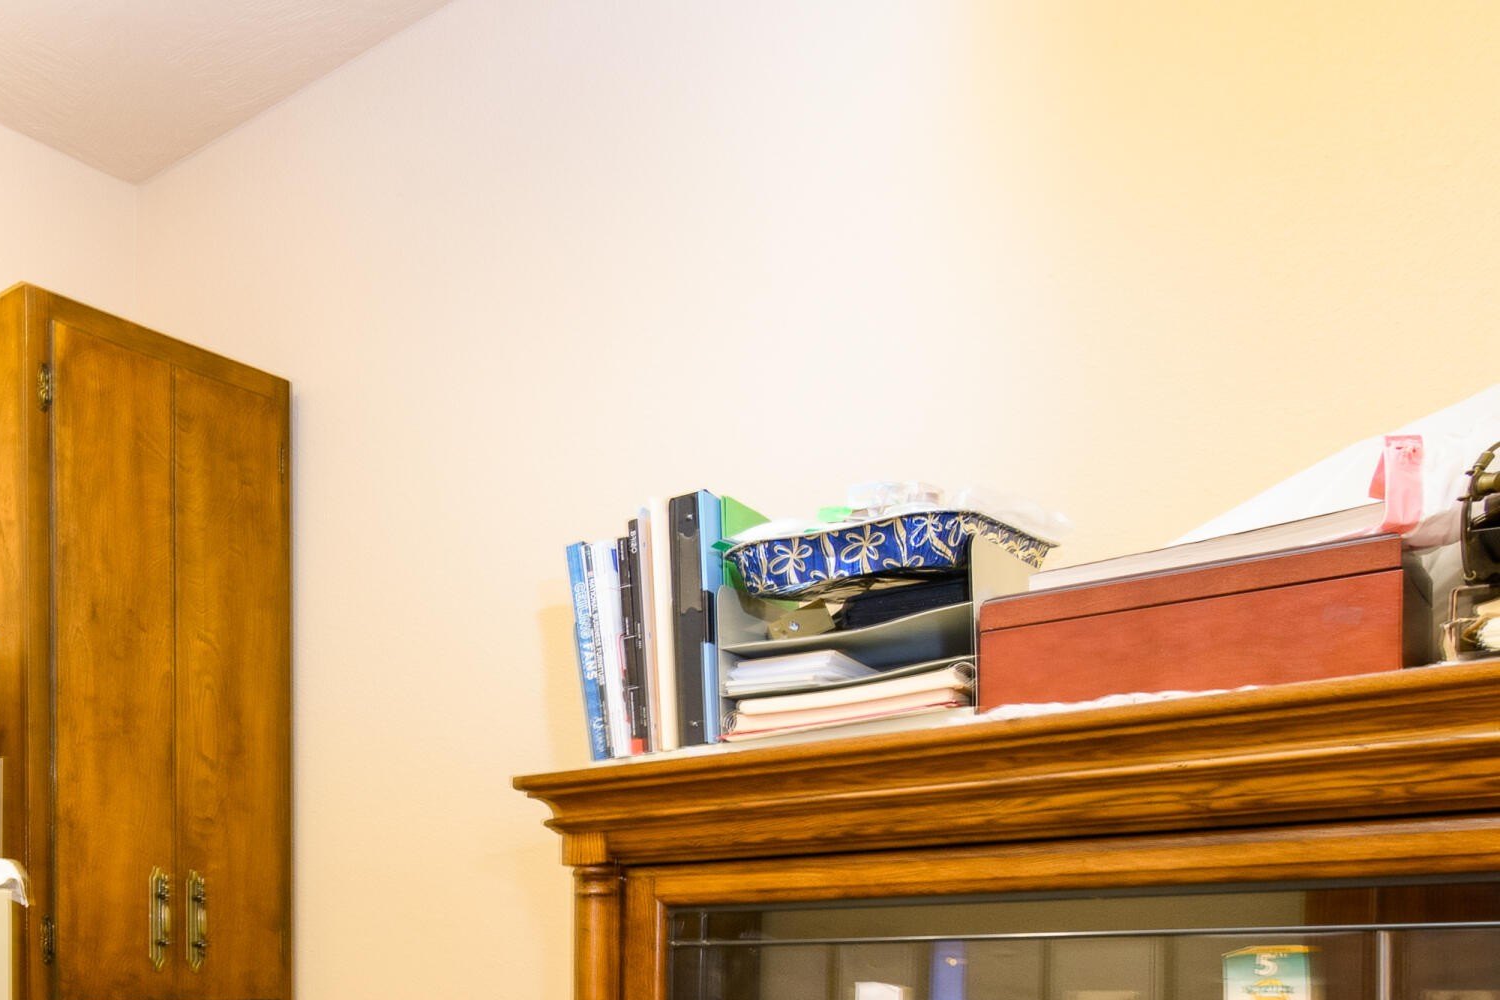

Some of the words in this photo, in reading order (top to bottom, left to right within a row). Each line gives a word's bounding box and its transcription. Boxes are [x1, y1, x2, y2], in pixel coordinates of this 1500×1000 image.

[574, 582, 591, 639] CEILING
[583, 643, 596, 680] FANS
[1253, 953, 1278, 976] 5
